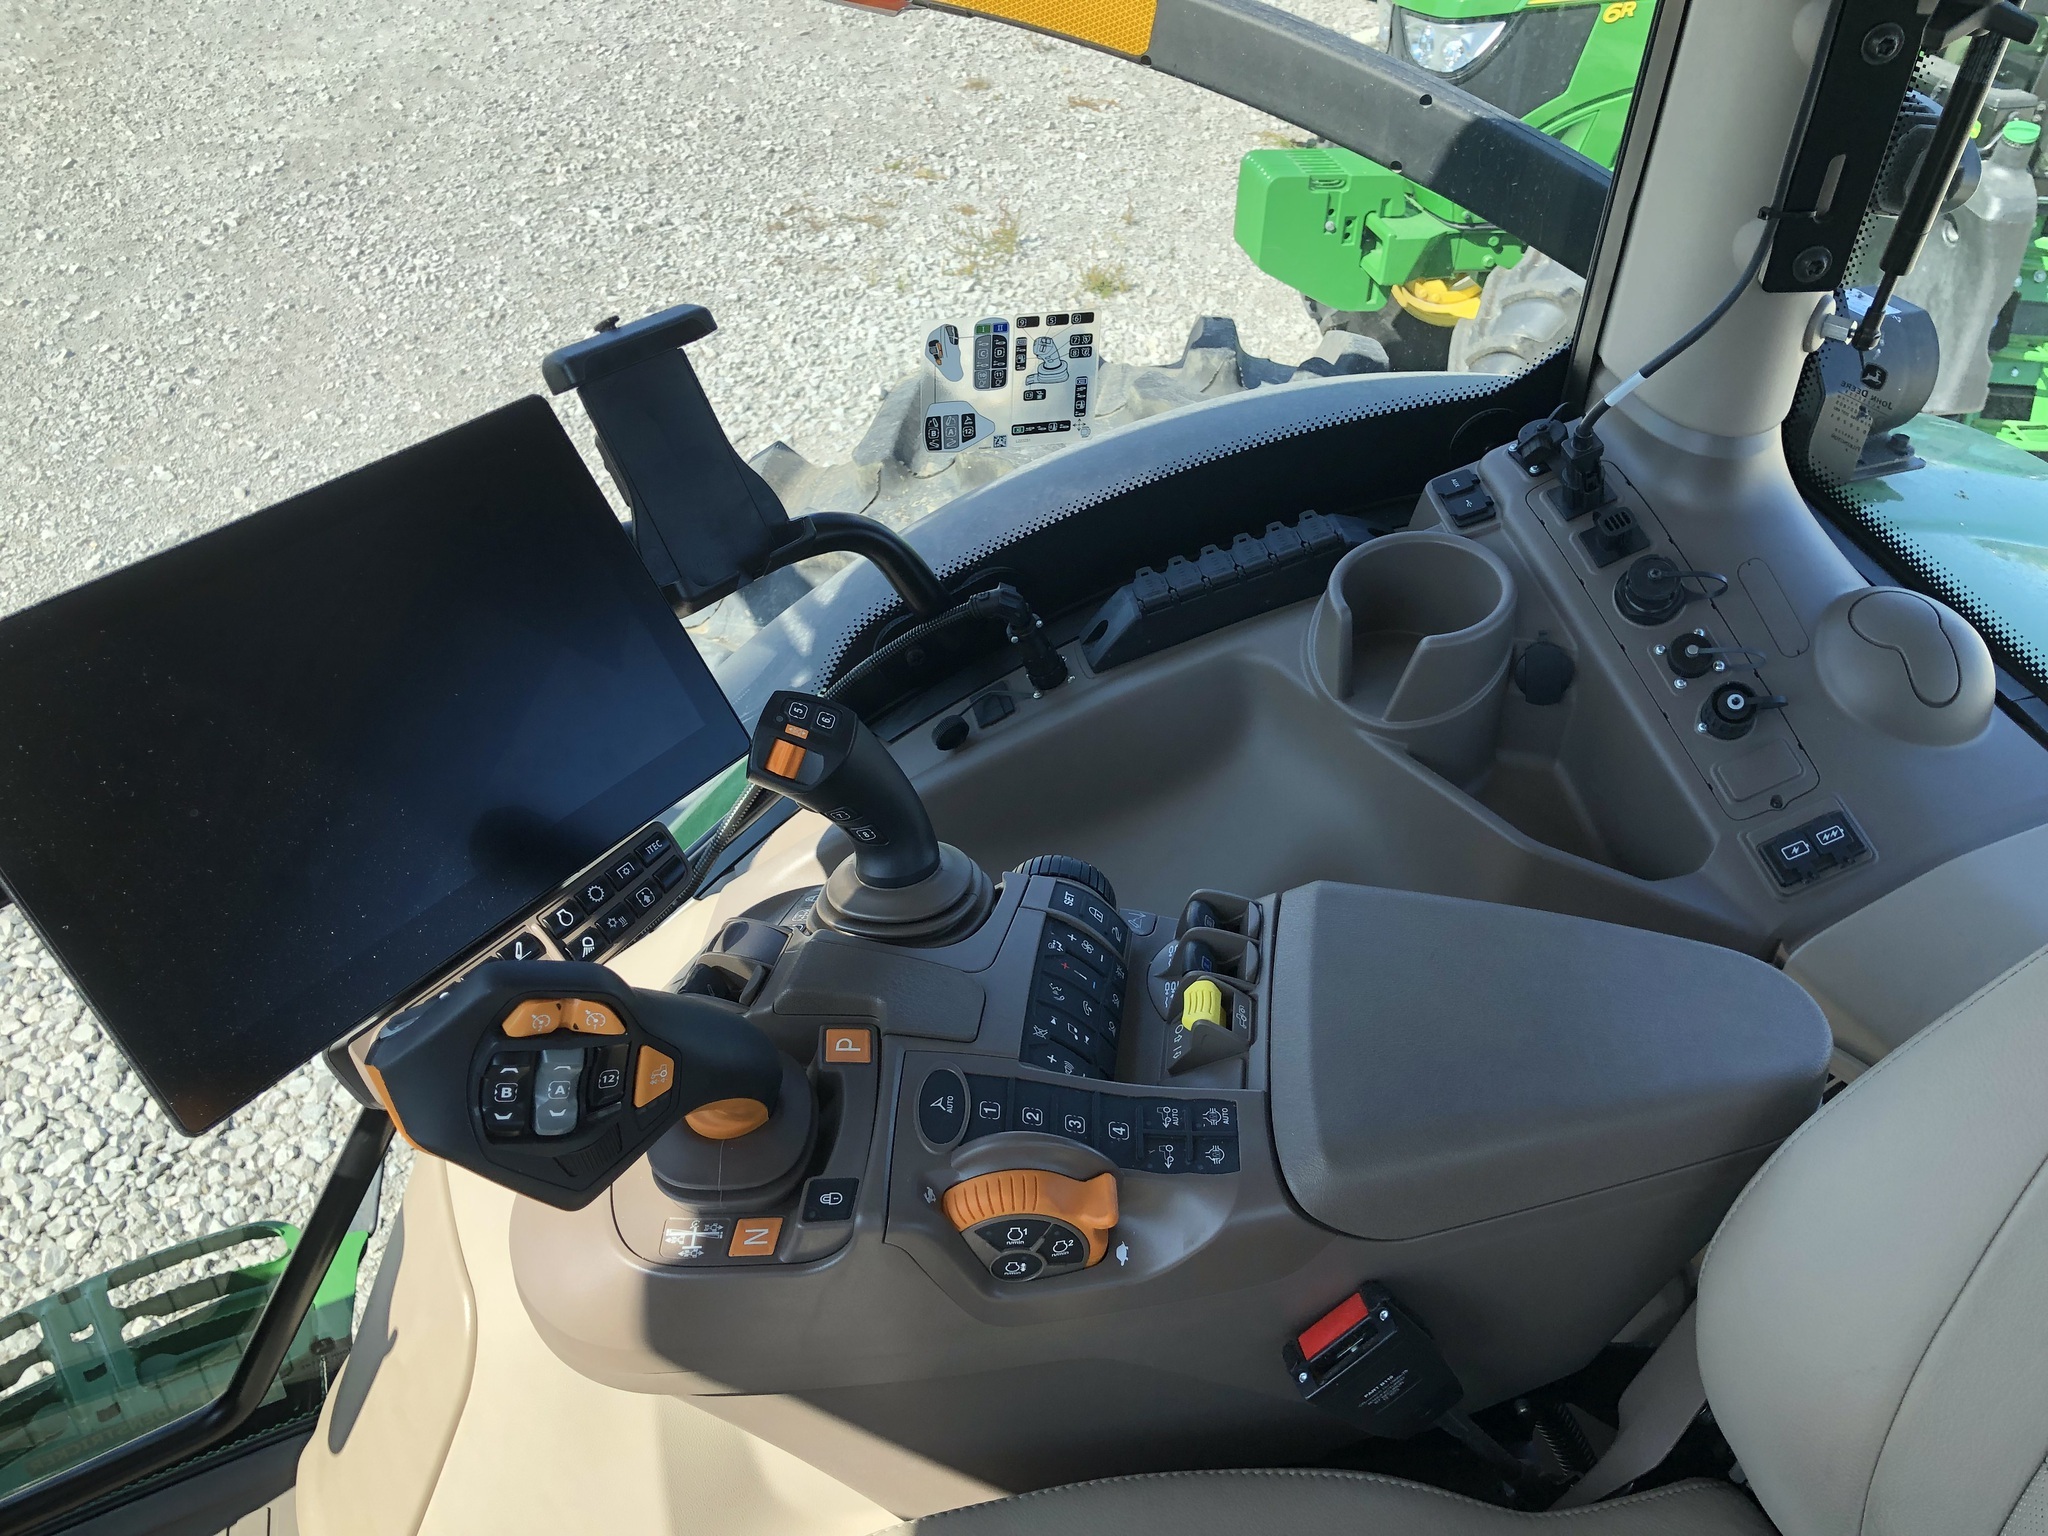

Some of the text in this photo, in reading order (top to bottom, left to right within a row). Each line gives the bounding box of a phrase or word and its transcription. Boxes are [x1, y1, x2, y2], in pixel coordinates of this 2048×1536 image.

[1602, 1, 1637, 24] 6R
[645, 839, 663, 856] iTEC
[1063, 891, 1075, 907] SET
[835, 1037, 861, 1052] P
[602, 1074, 616, 1085] 12
[501, 1087, 512, 1099] B
[554, 1085, 566, 1096] A
[946, 1095, 954, 1114] AUTO
[983, 1105, 998, 1115] 1
[1026, 1111, 1041, 1122] 2
[1068, 1118, 1082, 1129] 3
[1112, 1125, 1126, 1136] 4
[743, 1227, 769, 1246] N
